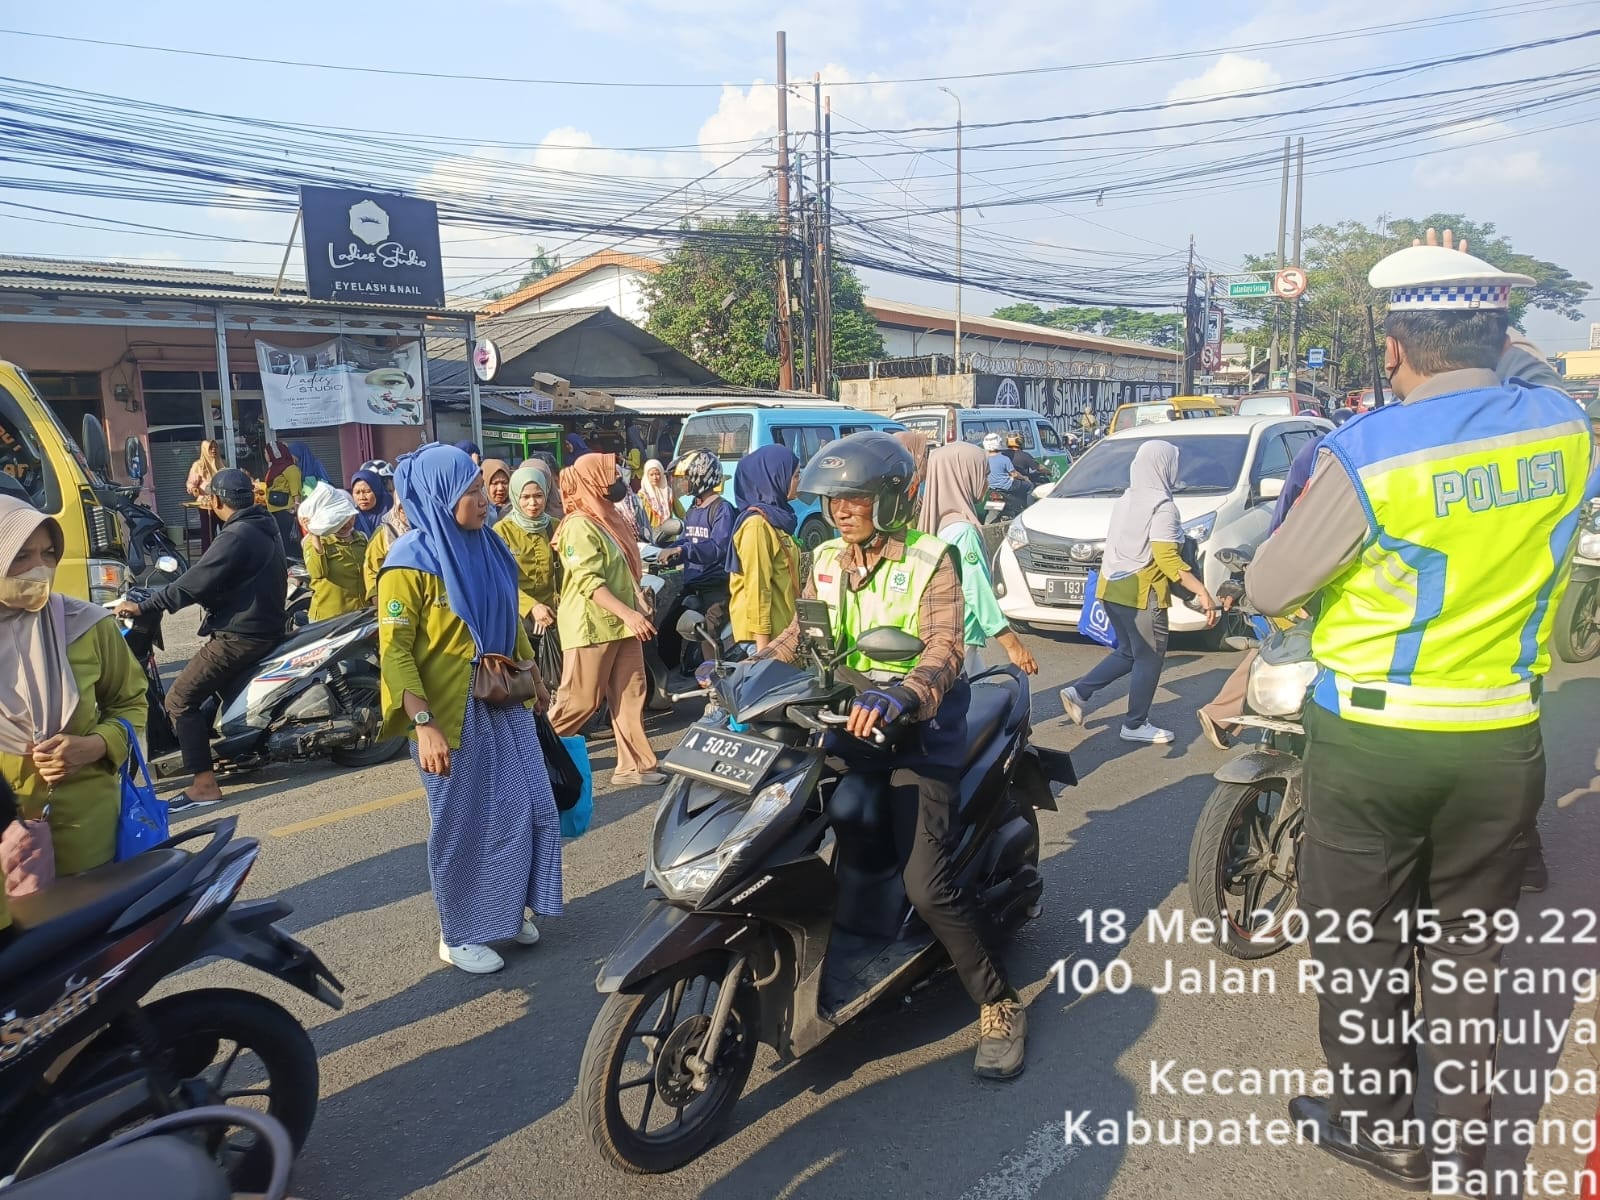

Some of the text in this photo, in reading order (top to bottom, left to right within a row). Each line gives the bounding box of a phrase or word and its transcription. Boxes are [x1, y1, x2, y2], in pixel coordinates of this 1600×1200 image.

[328, 241, 427, 268] Ladies Studio
[335, 281, 387, 293] EYELASH
[397, 284, 422, 295] NAIL
[299, 383, 344, 393] STUDIO
[1024, 379, 1048, 415] WE
[1053, 379, 1093, 416] SHALL
[1432, 449, 1566, 519] POLISI
[1048, 581, 1054, 593] B
[685, 732, 770, 767] A 5035 JX
[730, 874, 774, 907] HONDA
